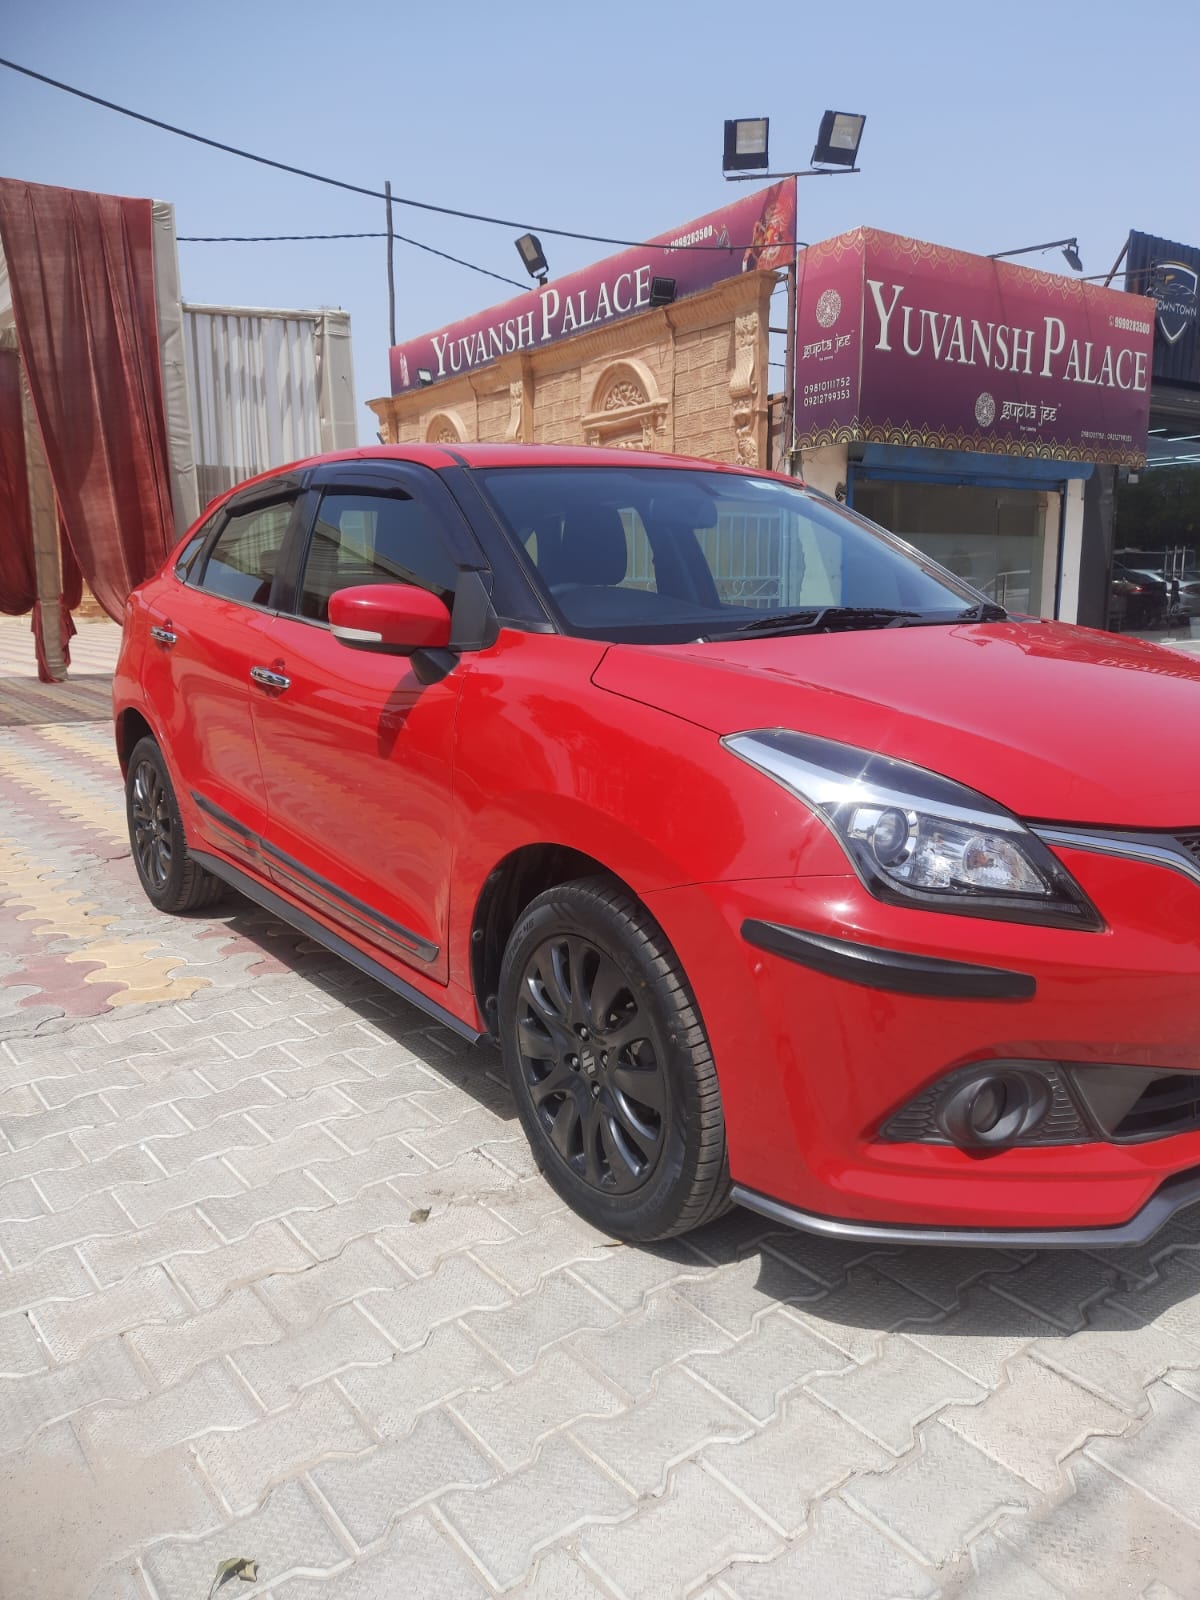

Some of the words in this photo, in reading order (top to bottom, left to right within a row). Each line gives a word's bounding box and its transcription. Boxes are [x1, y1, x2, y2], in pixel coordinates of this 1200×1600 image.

[430, 310, 535, 377] YUVANSH
[539, 265, 651, 341] PALACE
[866, 279, 1036, 375] YUVANSH
[1039, 316, 1149, 392] PALACE
[1155, 299, 1197, 317] OWNTOWN
[803, 389, 851, 407] 09212799353
